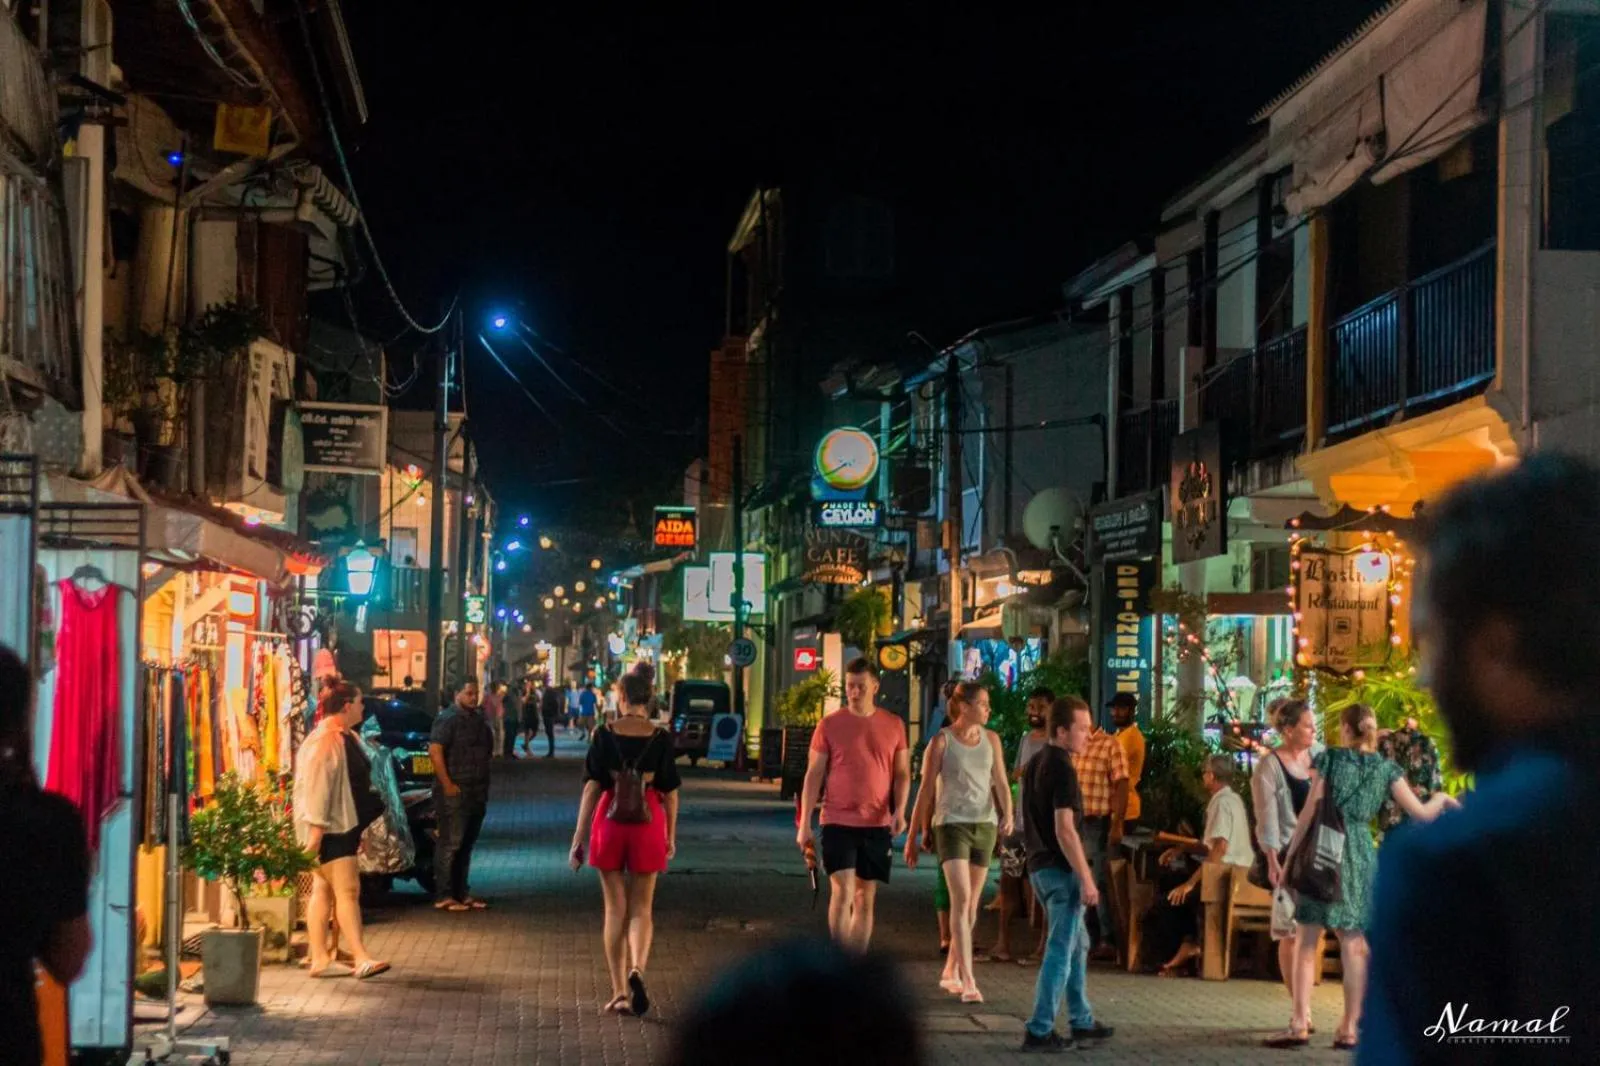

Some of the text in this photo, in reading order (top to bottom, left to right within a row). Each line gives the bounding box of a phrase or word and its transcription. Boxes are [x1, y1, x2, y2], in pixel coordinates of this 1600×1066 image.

[821, 508, 876, 525] CEYLON
[655, 519, 694, 533] AIDA
[1308, 592, 1380, 611] Restaurant
[1107, 658, 1147, 668] GEMS &
